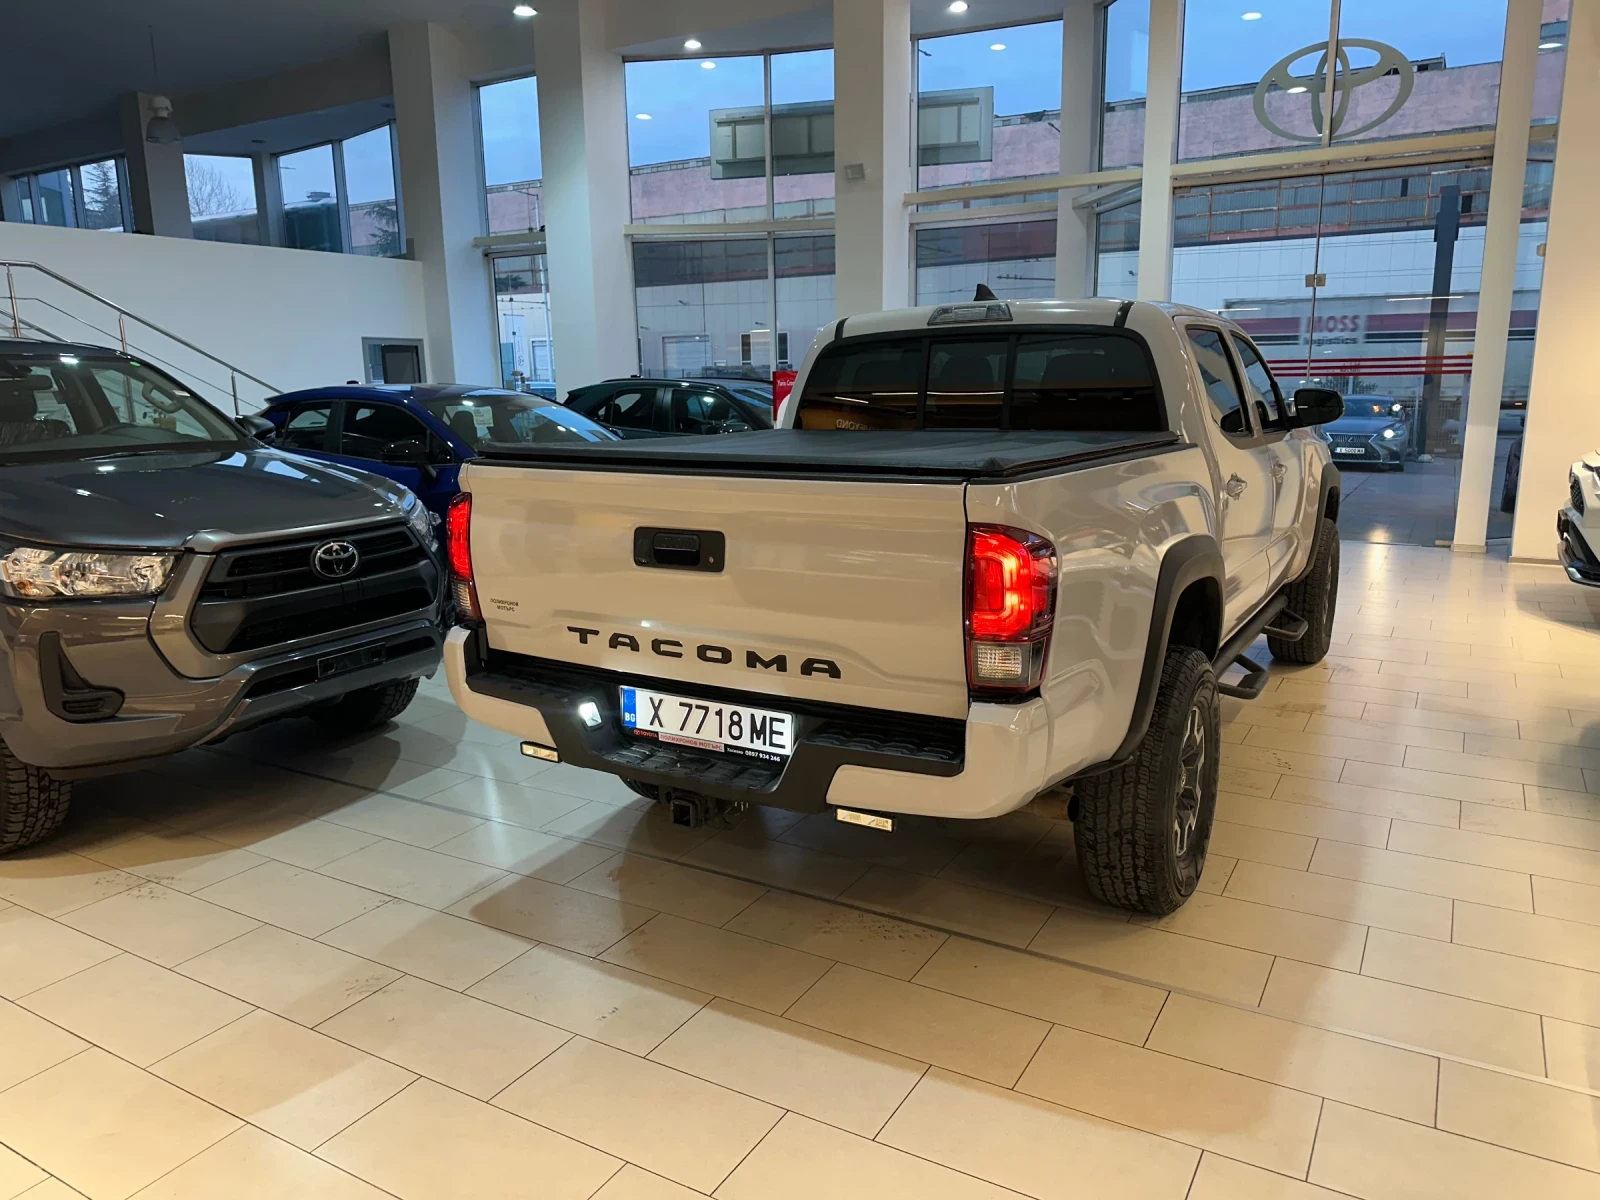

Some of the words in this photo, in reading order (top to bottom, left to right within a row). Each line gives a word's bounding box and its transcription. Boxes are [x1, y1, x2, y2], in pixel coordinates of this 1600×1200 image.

[1306, 315, 1360, 333] MOSS
[1303, 336, 1358, 346] logistics
[566, 626, 842, 680] TACOMA
[624, 712, 636, 723] BG
[678, 701, 744, 741] 7718
[750, 713, 786, 750] ME
[640, 731, 658, 739] TOYOTA
[660, 733, 698, 747] ПОЛИХРОНОВ
[698, 741, 723, 751] МОТЪРС
[744, 750, 759, 758] 0897
[758, 752, 770, 761] 934
